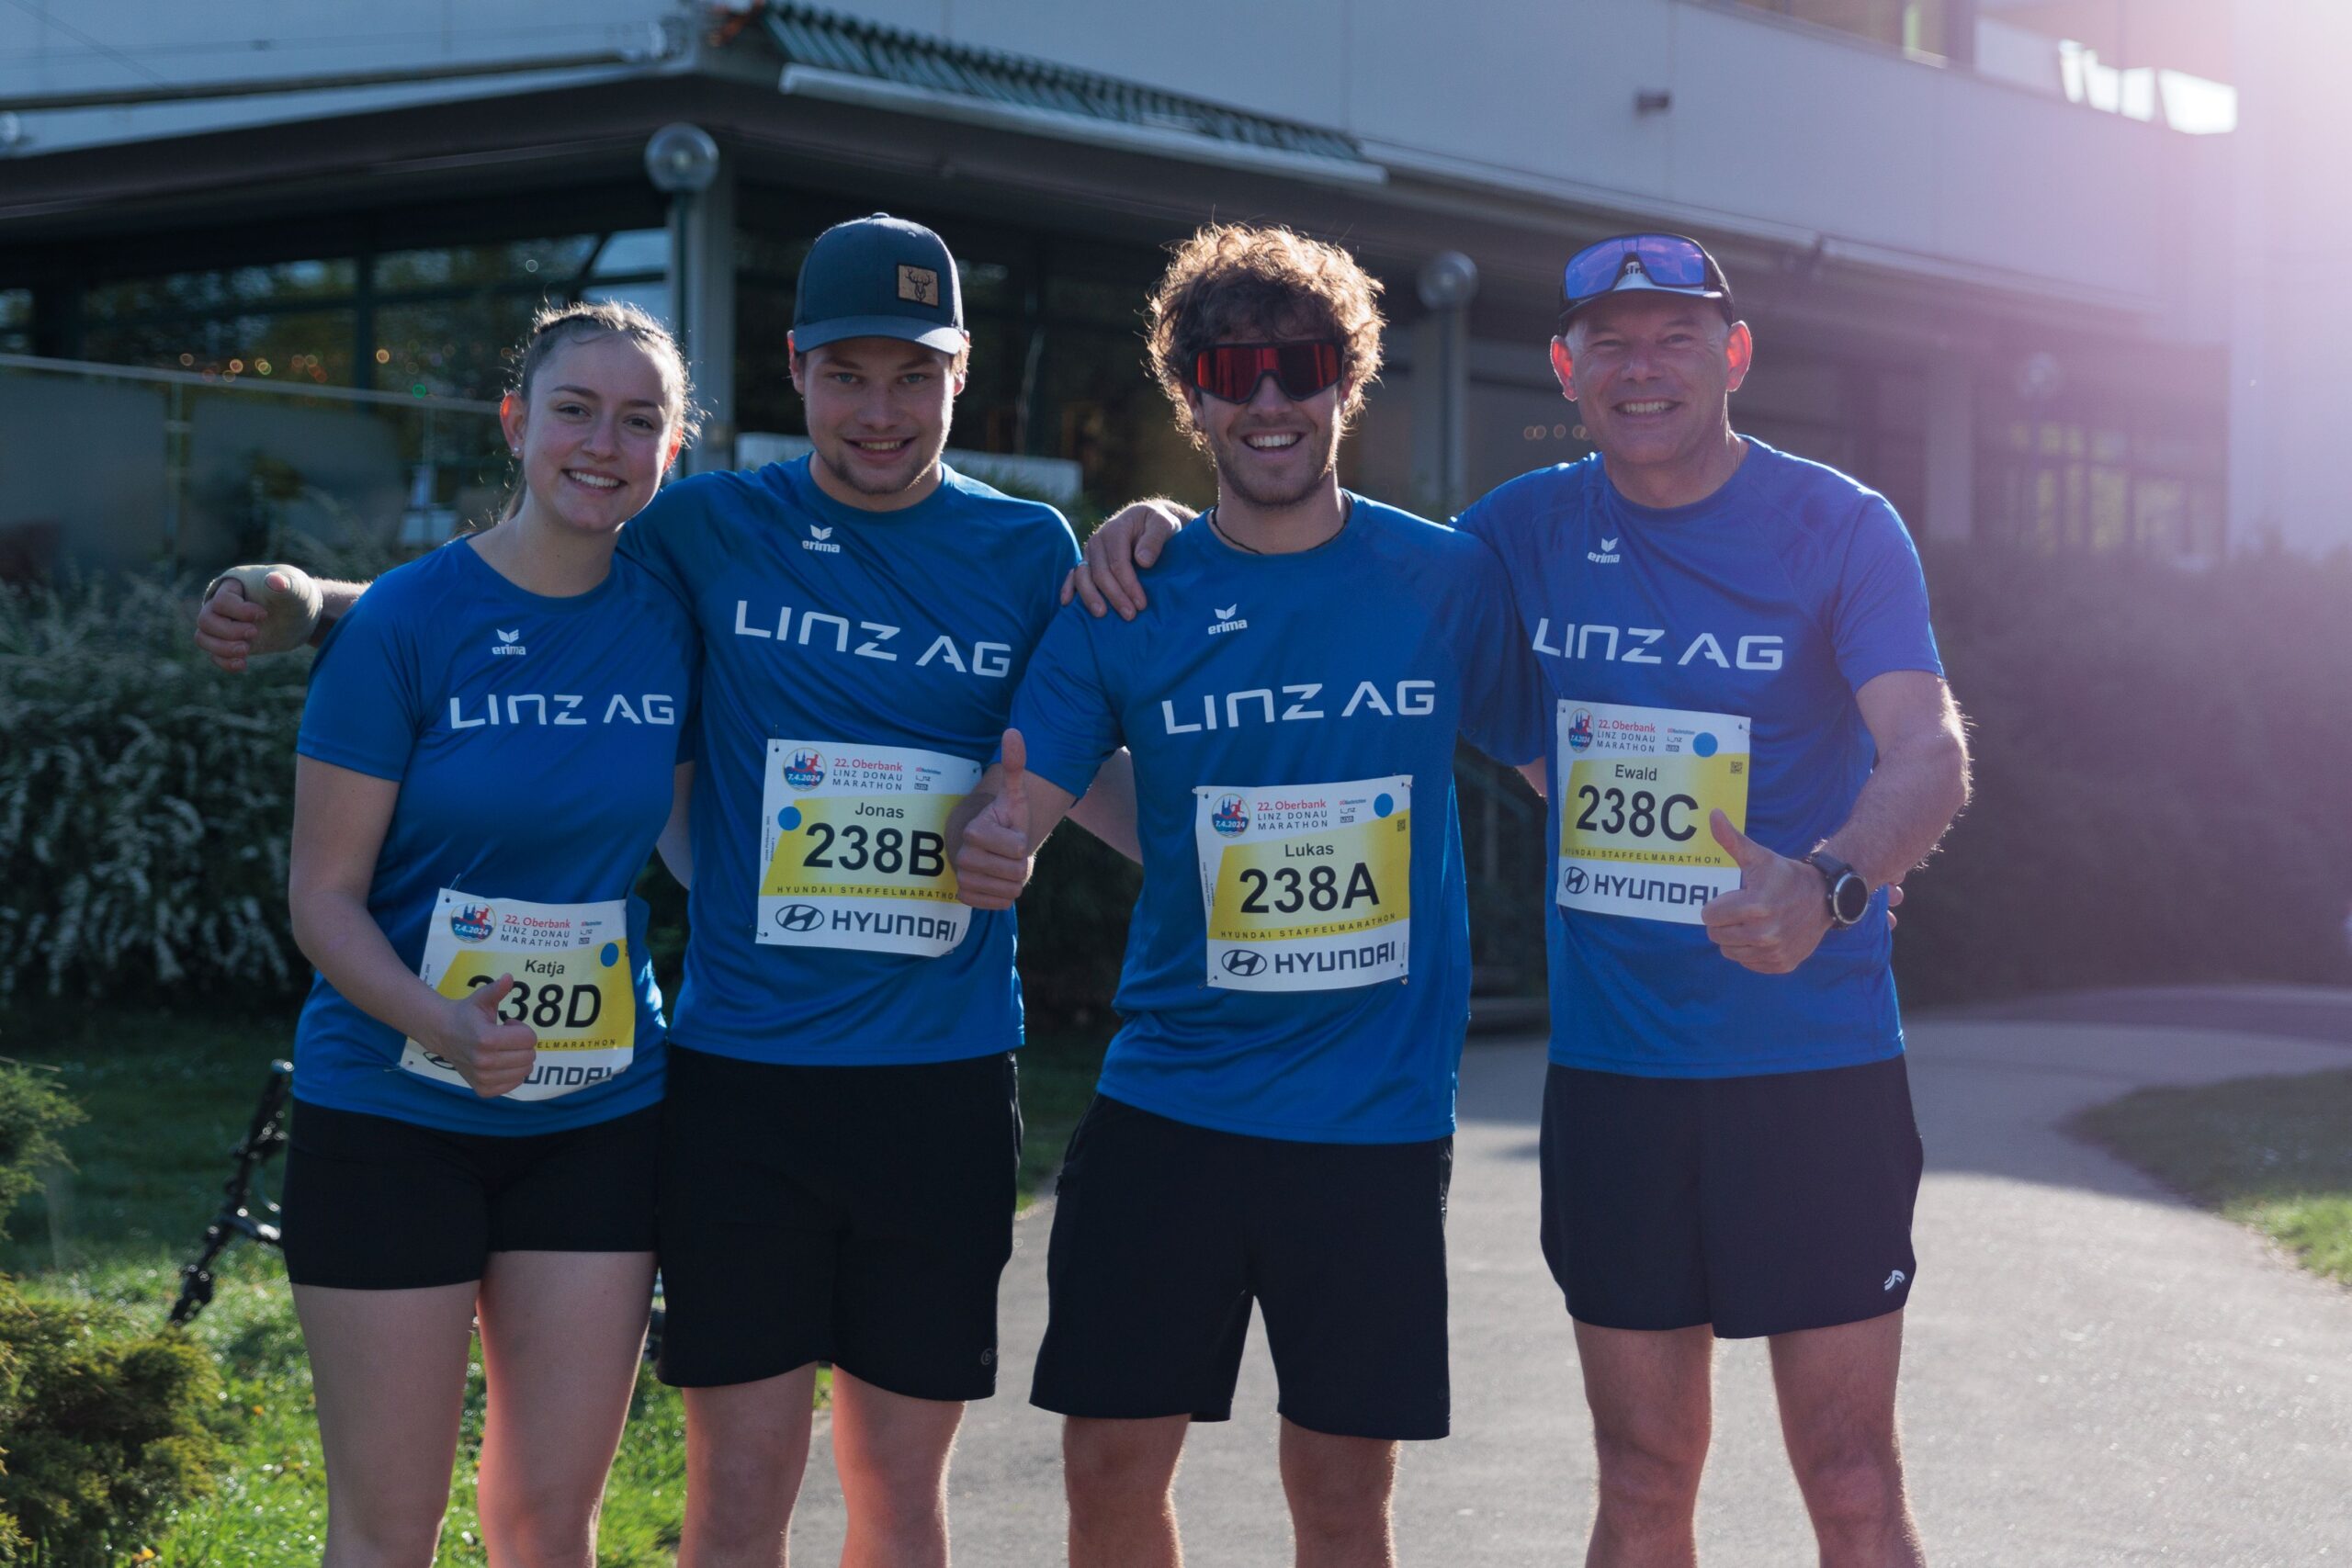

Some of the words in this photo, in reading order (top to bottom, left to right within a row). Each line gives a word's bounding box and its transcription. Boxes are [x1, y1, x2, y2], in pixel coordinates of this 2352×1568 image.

[802, 539, 840, 553] erima
[1587, 551, 1621, 564] erima
[1208, 619, 1248, 635] erima
[735, 600, 900, 661] LINZ
[915, 635, 1012, 678] AG
[1532, 617, 1665, 664] LINZ
[1677, 632, 1783, 671] AG
[492, 645, 526, 656] erima
[450, 694, 587, 728] LINZ
[603, 694, 674, 725] AG
[1161, 683, 1324, 735] LINZ
[1341, 680, 1435, 717] AG
[1599, 719, 1611, 729] 22.
[1611, 720, 1656, 733] Oberbank
[1598, 731, 1617, 739] LINZ
[1622, 732, 1656, 743] DONAU
[1597, 740, 1655, 752] MARATHON
[834, 758, 850, 768] 22.
[852, 759, 903, 772] Oberbank
[833, 770, 857, 778] LINZ
[864, 772, 903, 782] DONAU
[1615, 764, 1657, 781] Ewald
[832, 779, 902, 791] MARATHON
[854, 802, 904, 818] Jonas
[1257, 802, 1272, 811] 22.
[1275, 799, 1327, 810] Oberbank
[1287, 810, 1328, 819] DONAU
[1576, 784, 1699, 841] 238C
[1258, 820, 1328, 830] MARATHON
[802, 822, 944, 877] 238B
[1284, 843, 1334, 857] Lukas
[1602, 851, 1721, 863] STAFFELMARATHON
[1239, 862, 1380, 913] 238A
[504, 914, 520, 925] 22.
[523, 917, 571, 929] Oberbank
[831, 909, 956, 942] HYUNDAI
[1221, 931, 1272, 939] HYUNDAI
[1280, 913, 1396, 937] STAFFELMARATHON
[454, 923, 489, 935] 7.4.2024
[502, 925, 527, 935] LINZ
[533, 929, 571, 938] DONAU
[500, 934, 569, 947] MARATHON
[1274, 941, 1396, 974] HYUNDAI
[525, 959, 565, 977] Katja
